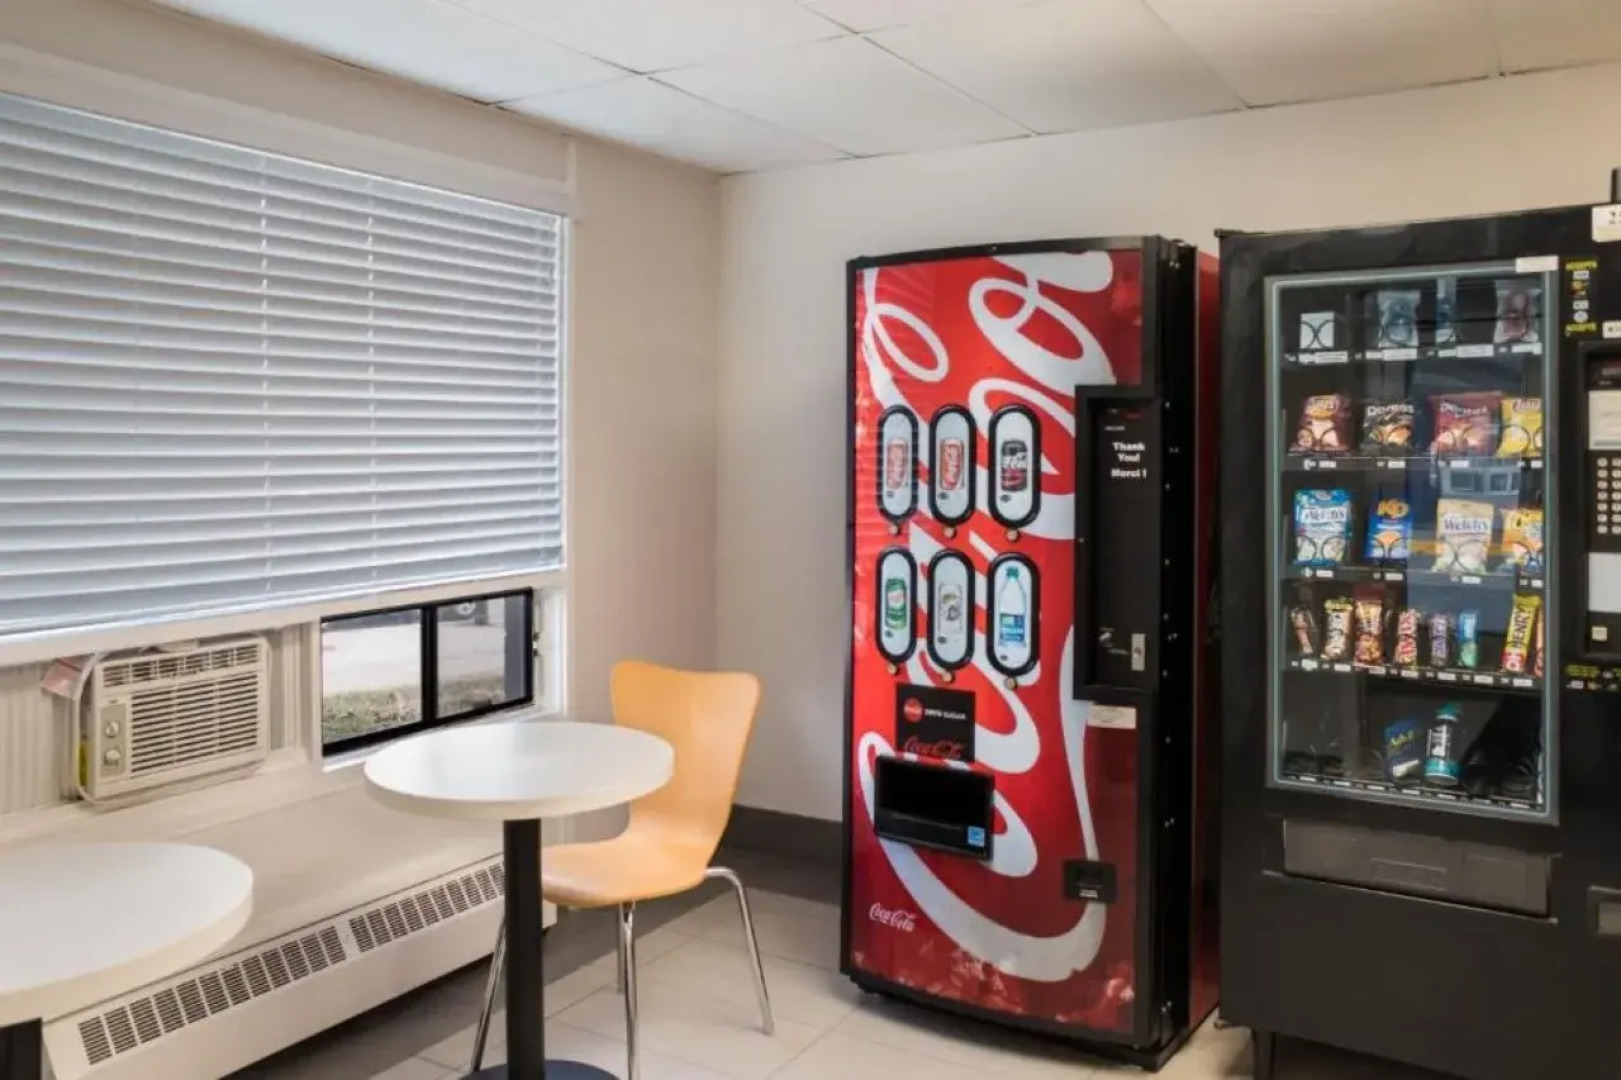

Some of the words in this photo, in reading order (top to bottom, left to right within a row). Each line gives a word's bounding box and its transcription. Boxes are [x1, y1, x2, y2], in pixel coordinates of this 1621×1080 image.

[1111, 441, 1146, 452] Thank
[1110, 467, 1141, 478] Merci
[868, 902, 917, 932] Coca-Cola
